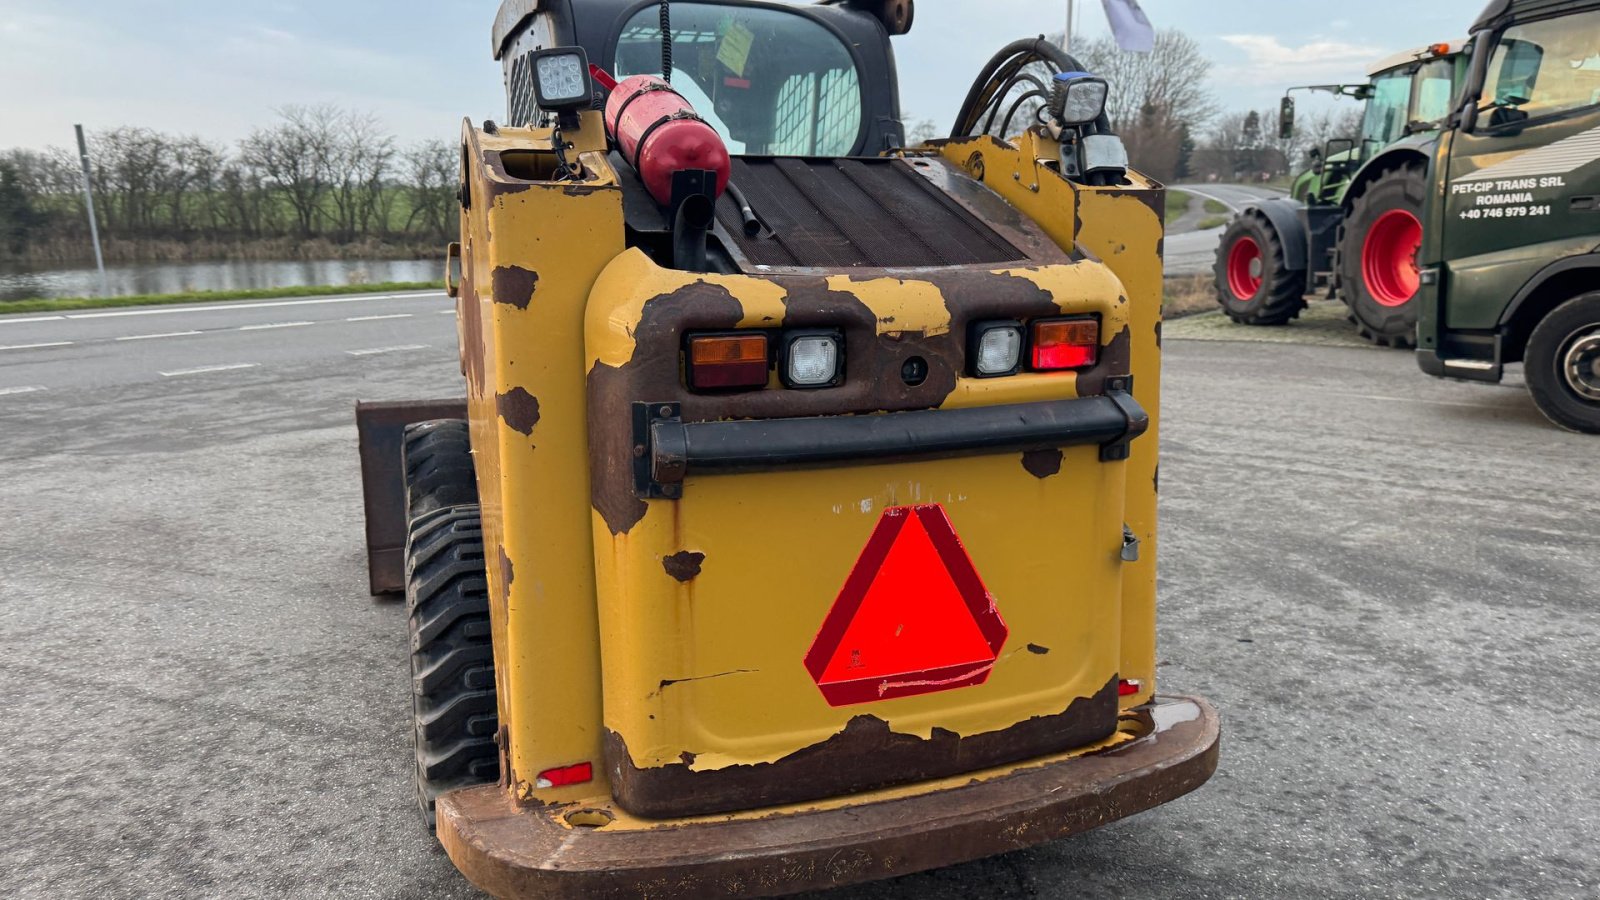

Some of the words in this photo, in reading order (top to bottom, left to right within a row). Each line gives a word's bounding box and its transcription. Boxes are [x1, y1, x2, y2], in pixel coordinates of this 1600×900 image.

[1452, 182, 1493, 194] PET-CIP
[1496, 178, 1537, 190] TRANS
[1539, 176, 1565, 187] SRL
[1476, 192, 1533, 205] ROMANIA
[1459, 209, 1480, 219] +40
[1483, 207, 1503, 218] 746
[1505, 206, 1527, 217] 979
[1529, 205, 1551, 215] 241
